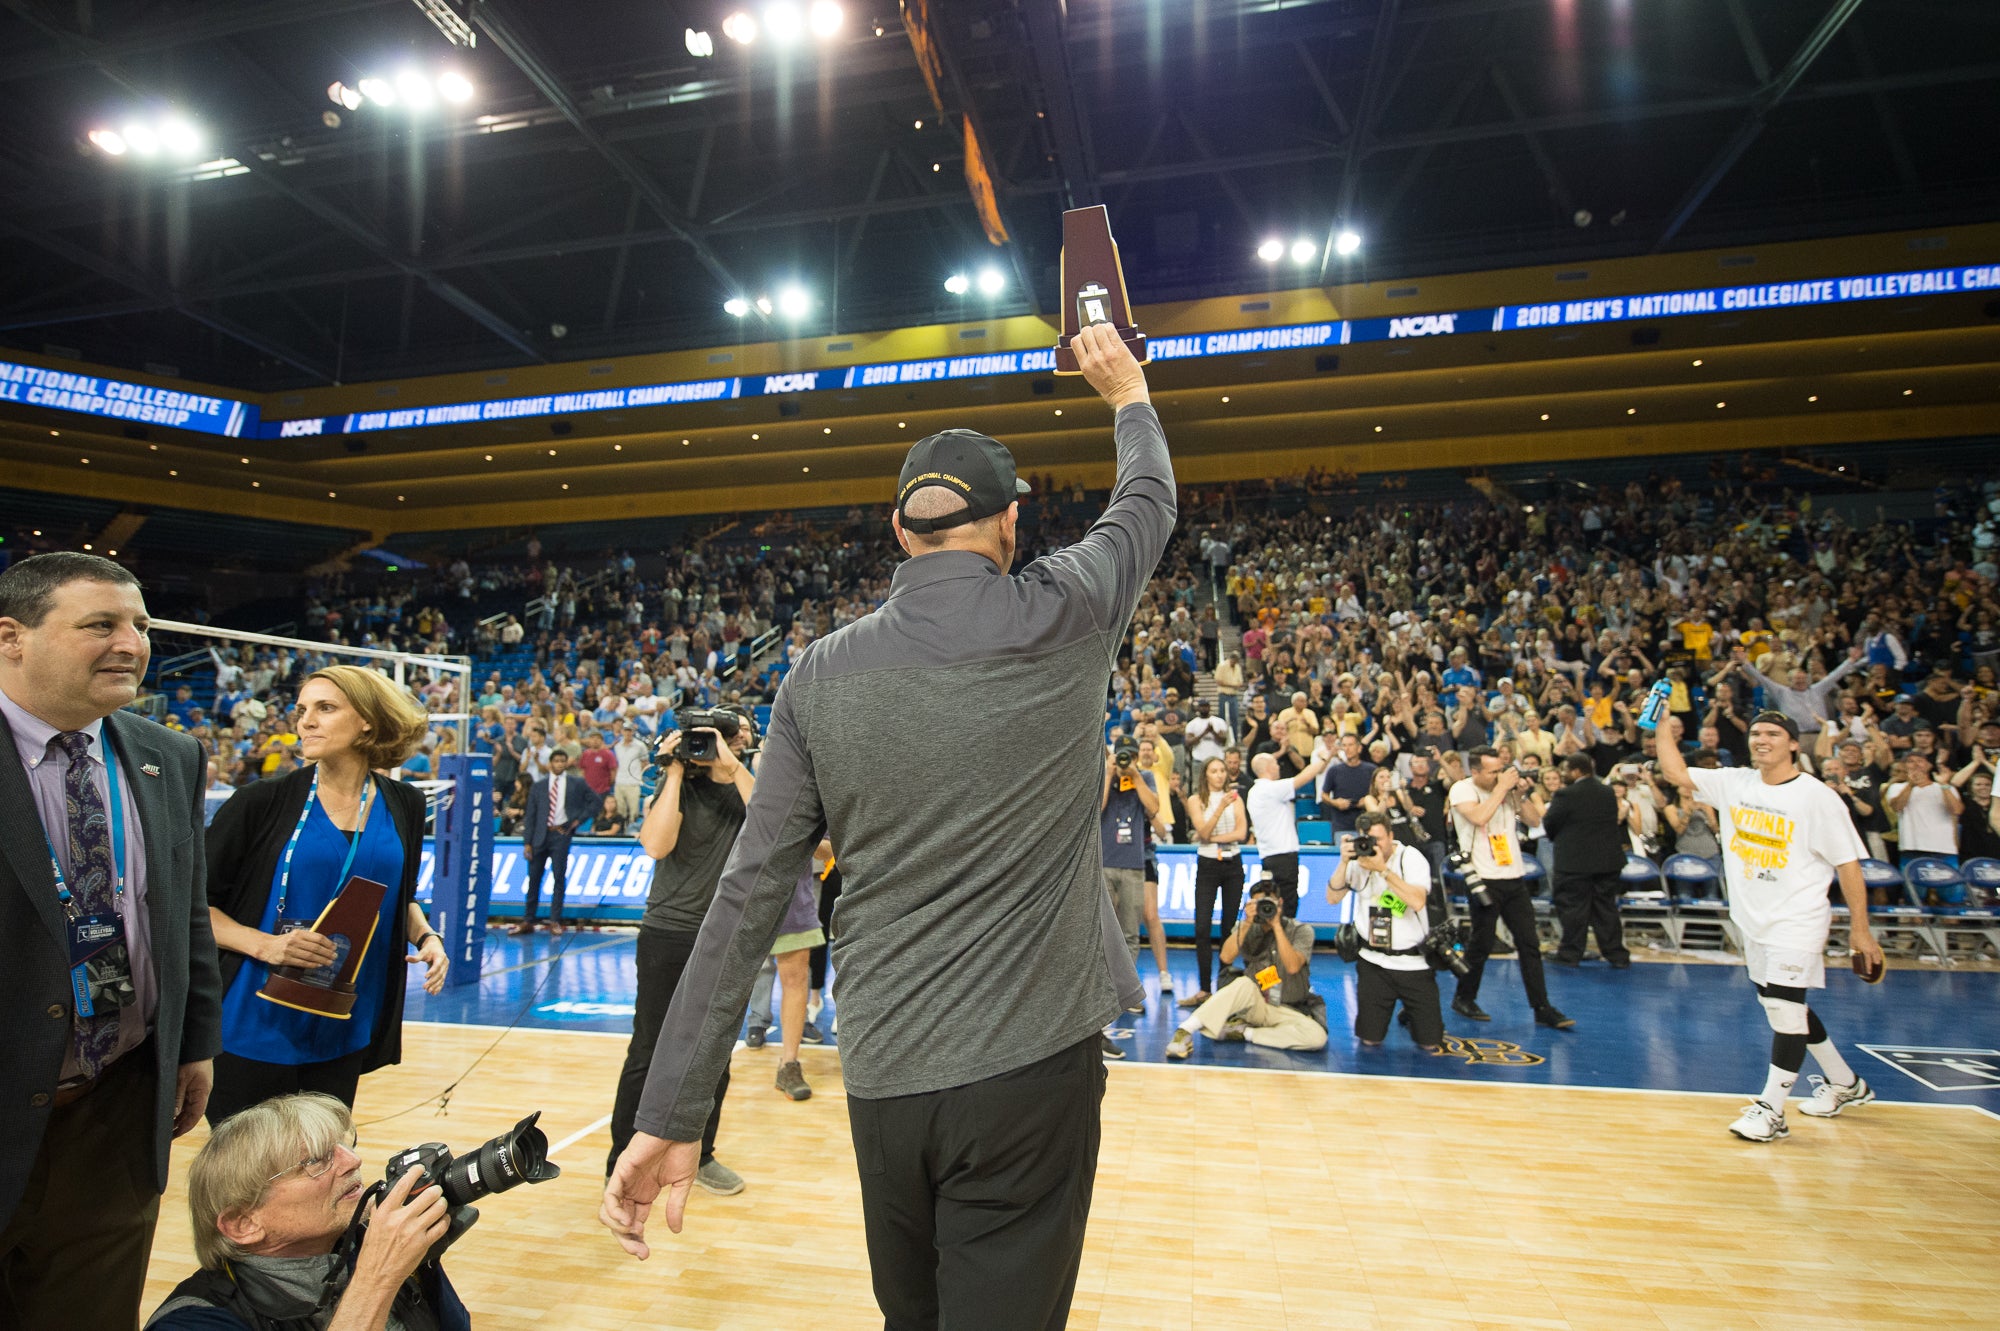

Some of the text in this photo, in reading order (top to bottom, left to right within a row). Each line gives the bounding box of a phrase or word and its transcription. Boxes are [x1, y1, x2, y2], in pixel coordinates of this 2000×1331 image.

[1516, 304, 1561, 327] 2018
[1565, 299, 1624, 323] MEN'S
[1628, 291, 1718, 317] NATIONAL
[1723, 282, 1833, 309] COLLEGIATE
[1839, 270, 1958, 299] VOLLEYBALL
[1388, 314, 1457, 338] NCAA
[862, 365, 899, 385] 2018
[900, 360, 948, 382] MEN'S
[949, 354, 1018, 377] NATIONAL
[1205, 325, 1332, 355] CHAMPIONSHIP
[103, 381, 223, 416] COLLEGIATE
[763, 373, 820, 394] NCAA
[26, 386, 191, 426] CHAMPIONSHIP
[388, 409, 425, 428] MEN'S
[426, 404, 481, 425] NATIONAL
[482, 396, 552, 419] COLLEGIATE
[553, 389, 625, 413] VOLLEYBALL
[627, 381, 727, 406] CHAMPIONSHIP
[280, 418, 323, 438] NCAA
[918, 472, 941, 482] NATIONAL
[943, 474, 972, 491] CHAMPIONS
[464, 791, 483, 961] VOLLEYBALL
